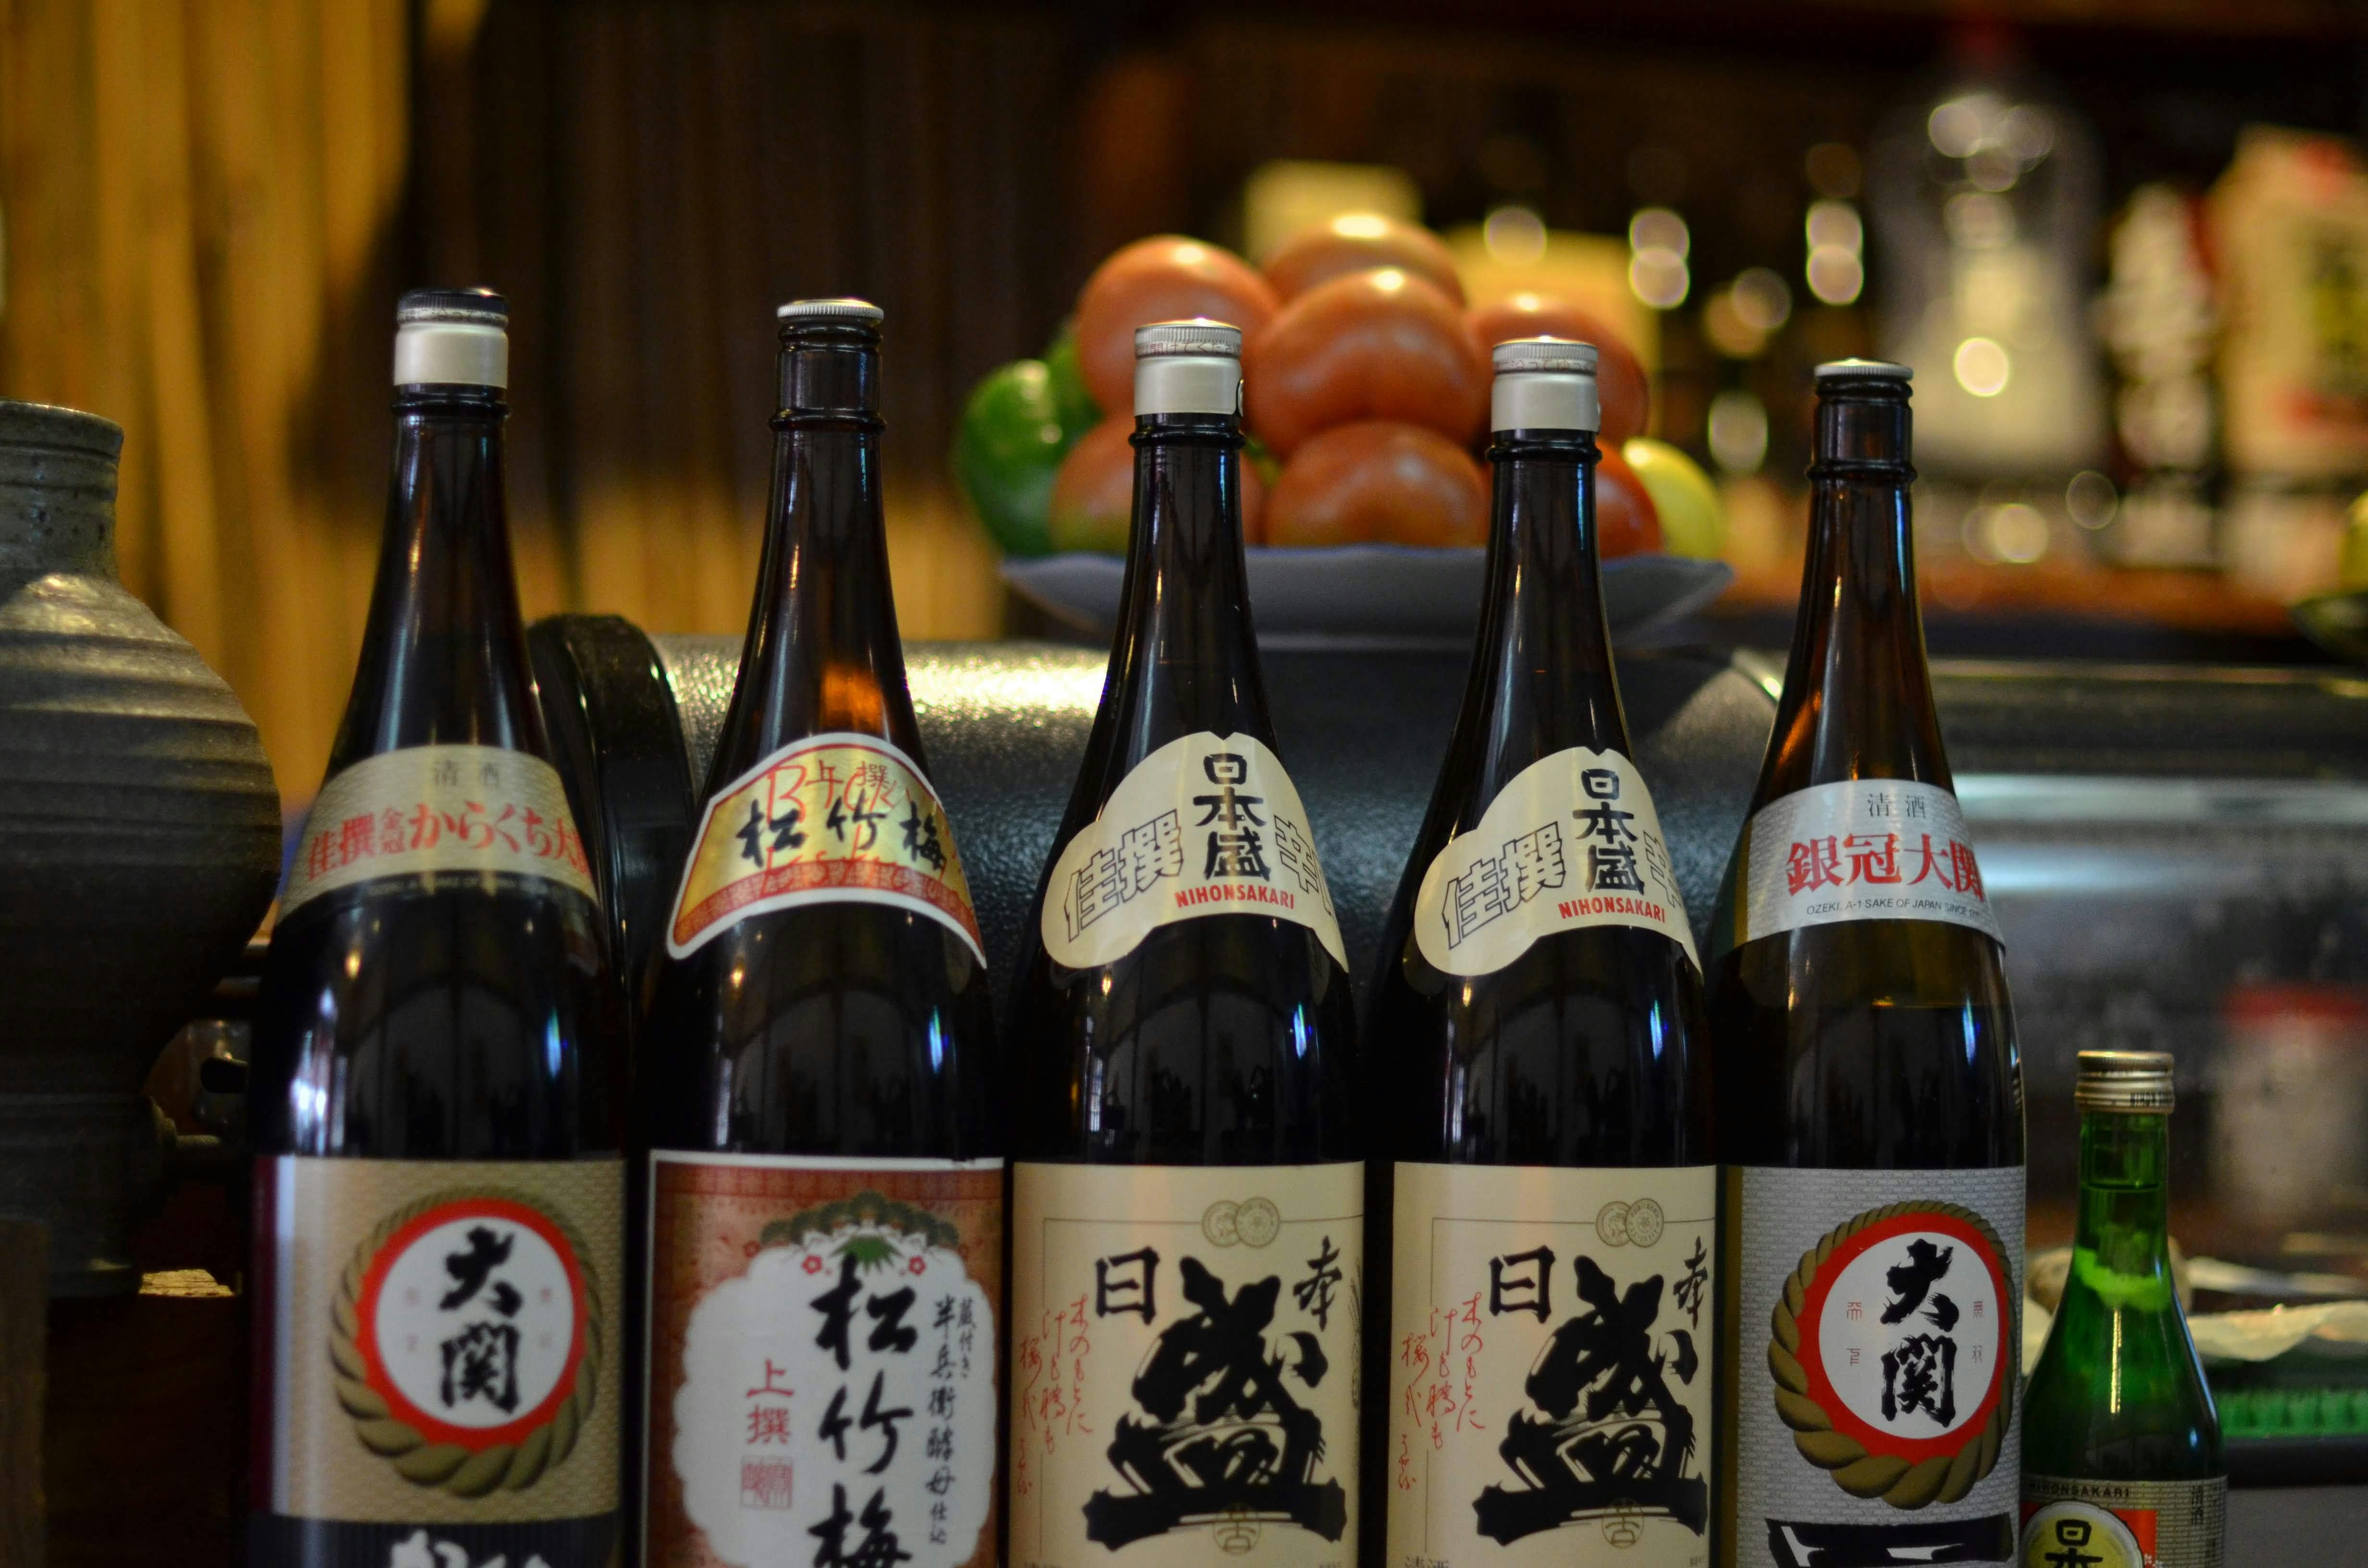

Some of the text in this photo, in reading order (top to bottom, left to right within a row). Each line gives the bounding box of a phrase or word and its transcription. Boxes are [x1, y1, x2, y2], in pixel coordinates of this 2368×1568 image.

[737, 788, 948, 870] 松竹梅
[1193, 753, 1271, 882] 日本盛
[1572, 768, 1644, 895] 日本盛
[1867, 793, 1926, 818] 清酒
[1063, 808, 1184, 943] 佳撰
[1175, 884, 1295, 909] NIHONSAKARI
[1442, 821, 1566, 950] 佳撰
[1557, 897, 1665, 923] NIHONSAKARI
[1786, 833, 1985, 903] 銀冠大関
[1845, 900, 1862, 909] A-1
[1864, 898, 1893, 909] SAKE
[1896, 898, 1910, 908] OF
[1912, 899, 1941, 910] JAPAN
[439, 1225, 523, 1414] 大関
[1880, 1238, 1961, 1428] 大関
[746, 1359, 795, 1446] 上撰
[807, 1252, 919, 1568] 松竹梅
